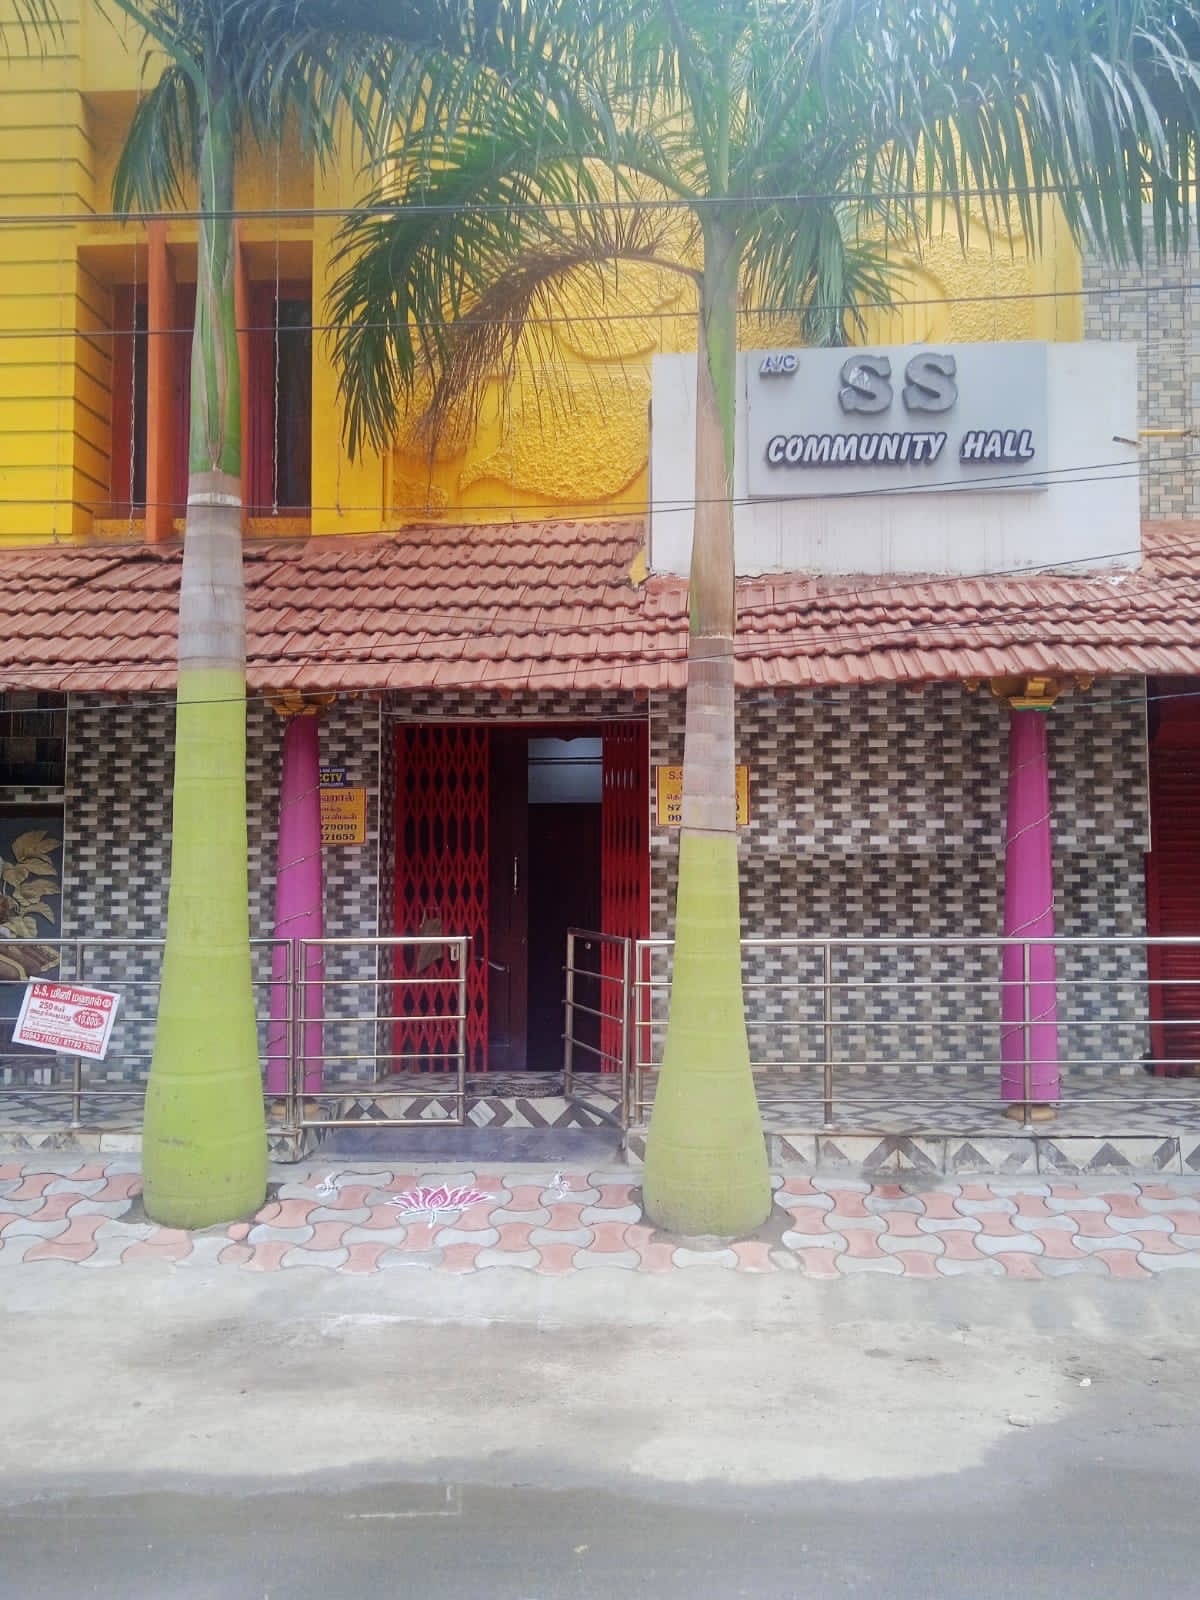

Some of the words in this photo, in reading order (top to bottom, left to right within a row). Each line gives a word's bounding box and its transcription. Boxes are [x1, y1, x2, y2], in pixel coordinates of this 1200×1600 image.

[759, 354, 799, 376] A/C
[839, 352, 958, 413] SS
[766, 432, 947, 467] COMMUNITY
[960, 430, 1035, 464] HALL
[39, 1001, 53, 1010] 250
